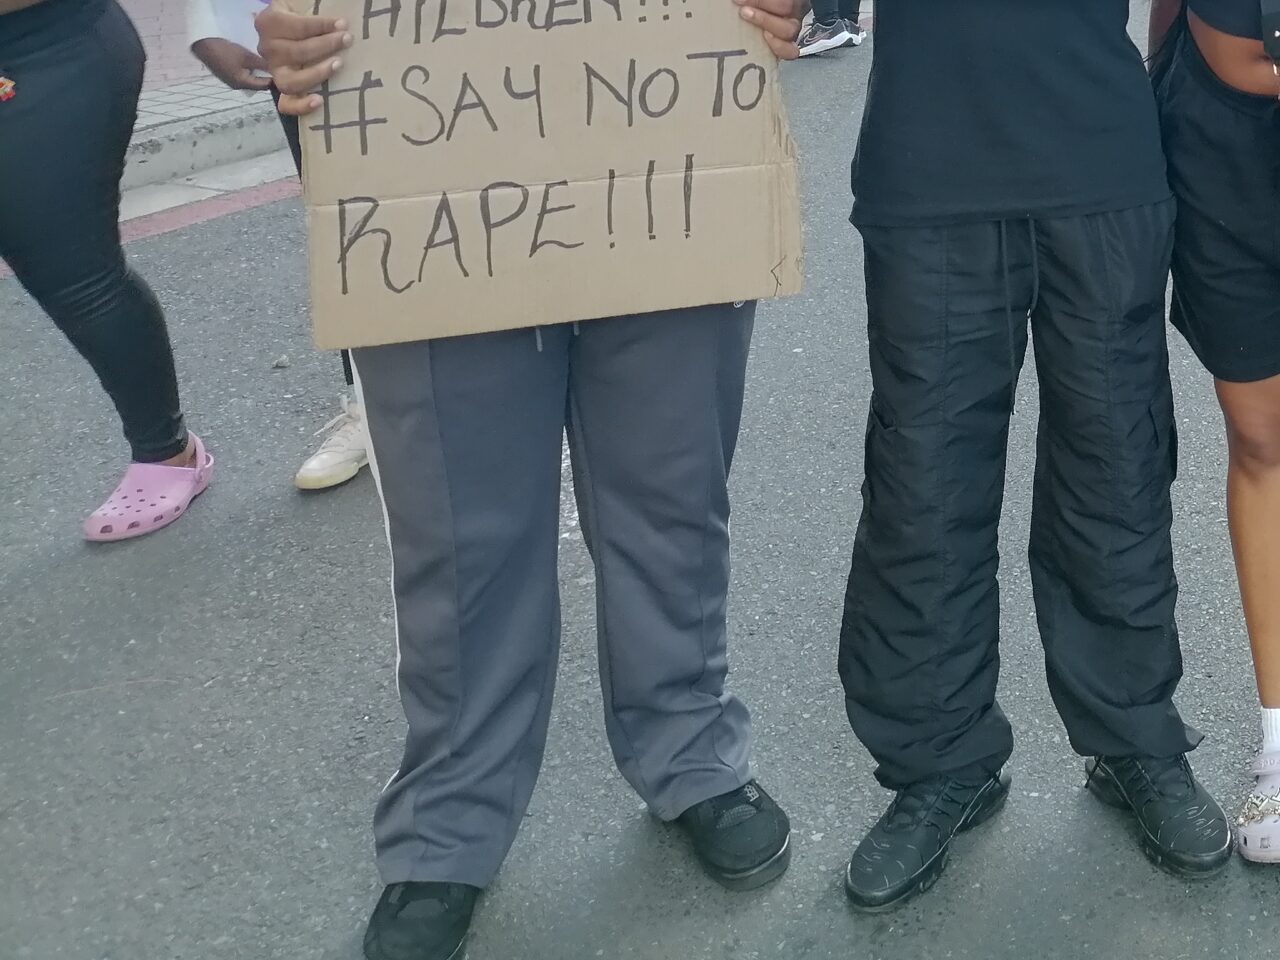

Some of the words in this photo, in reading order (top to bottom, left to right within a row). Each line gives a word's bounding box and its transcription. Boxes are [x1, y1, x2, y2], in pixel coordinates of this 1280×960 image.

[584, 58, 680, 127] NO
[686, 49, 767, 118] TO
[336, 153, 695, 296] RAPE!!!
